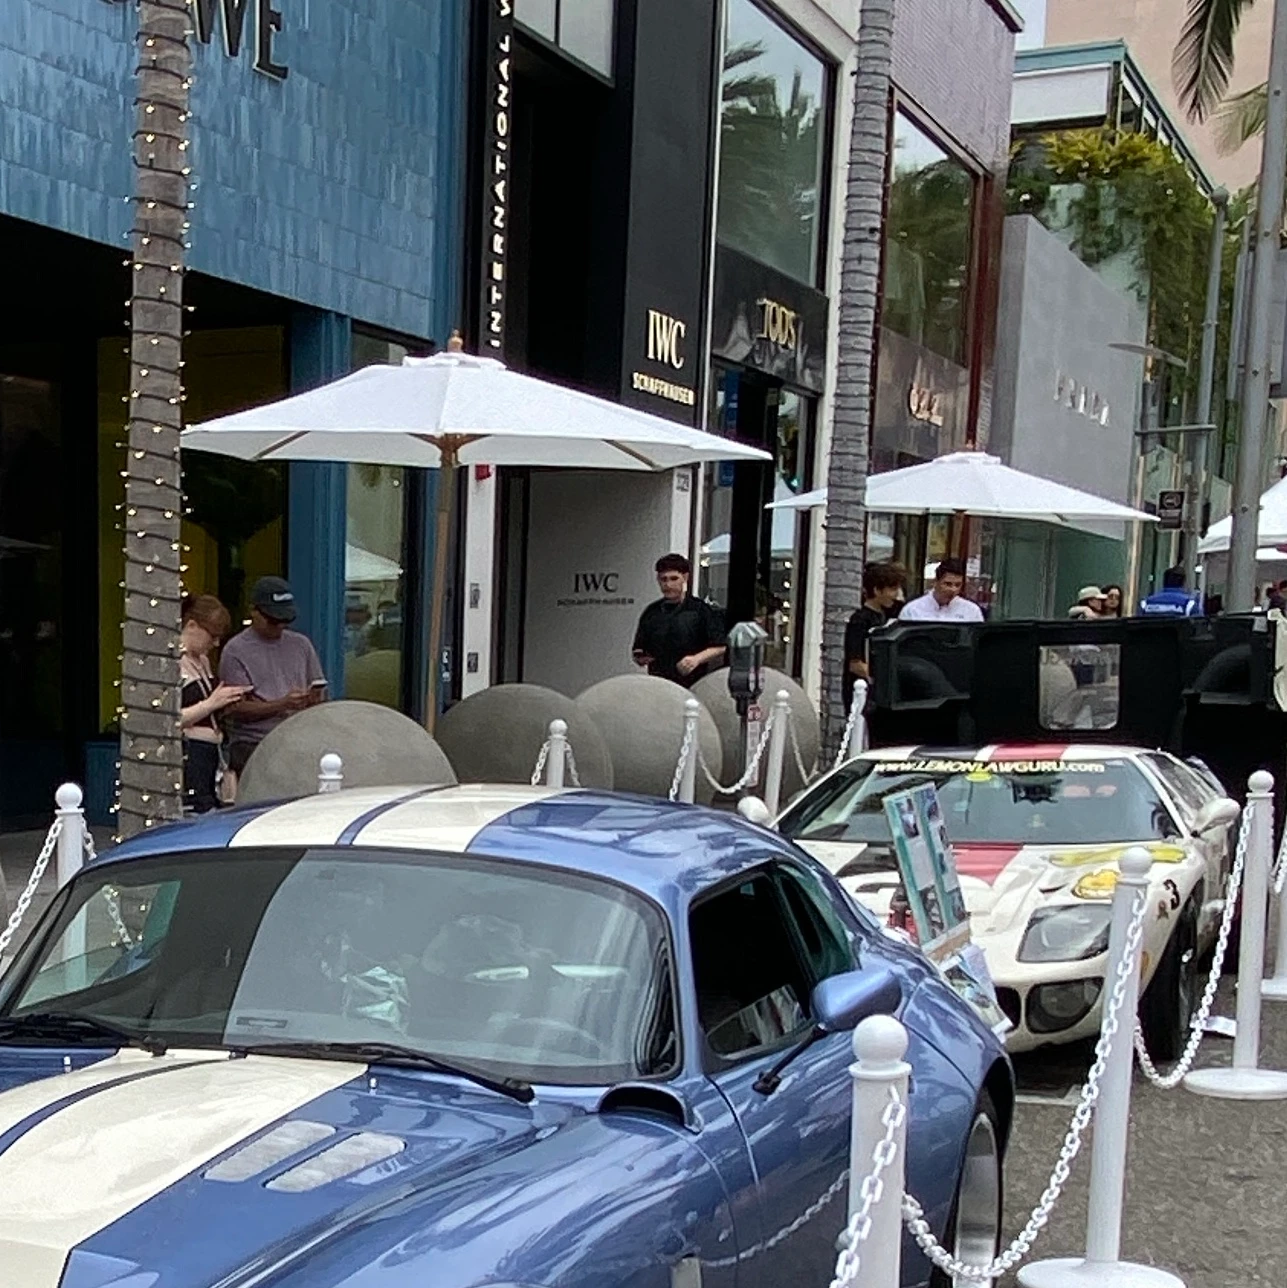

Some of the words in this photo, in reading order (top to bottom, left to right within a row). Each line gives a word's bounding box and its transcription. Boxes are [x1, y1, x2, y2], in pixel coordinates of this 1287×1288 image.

[490, 35, 510, 348] INTERNATIONAL
[647, 309, 686, 370] IWC
[574, 572, 619, 593] IWC
[1163, 879, 1181, 910] 3
